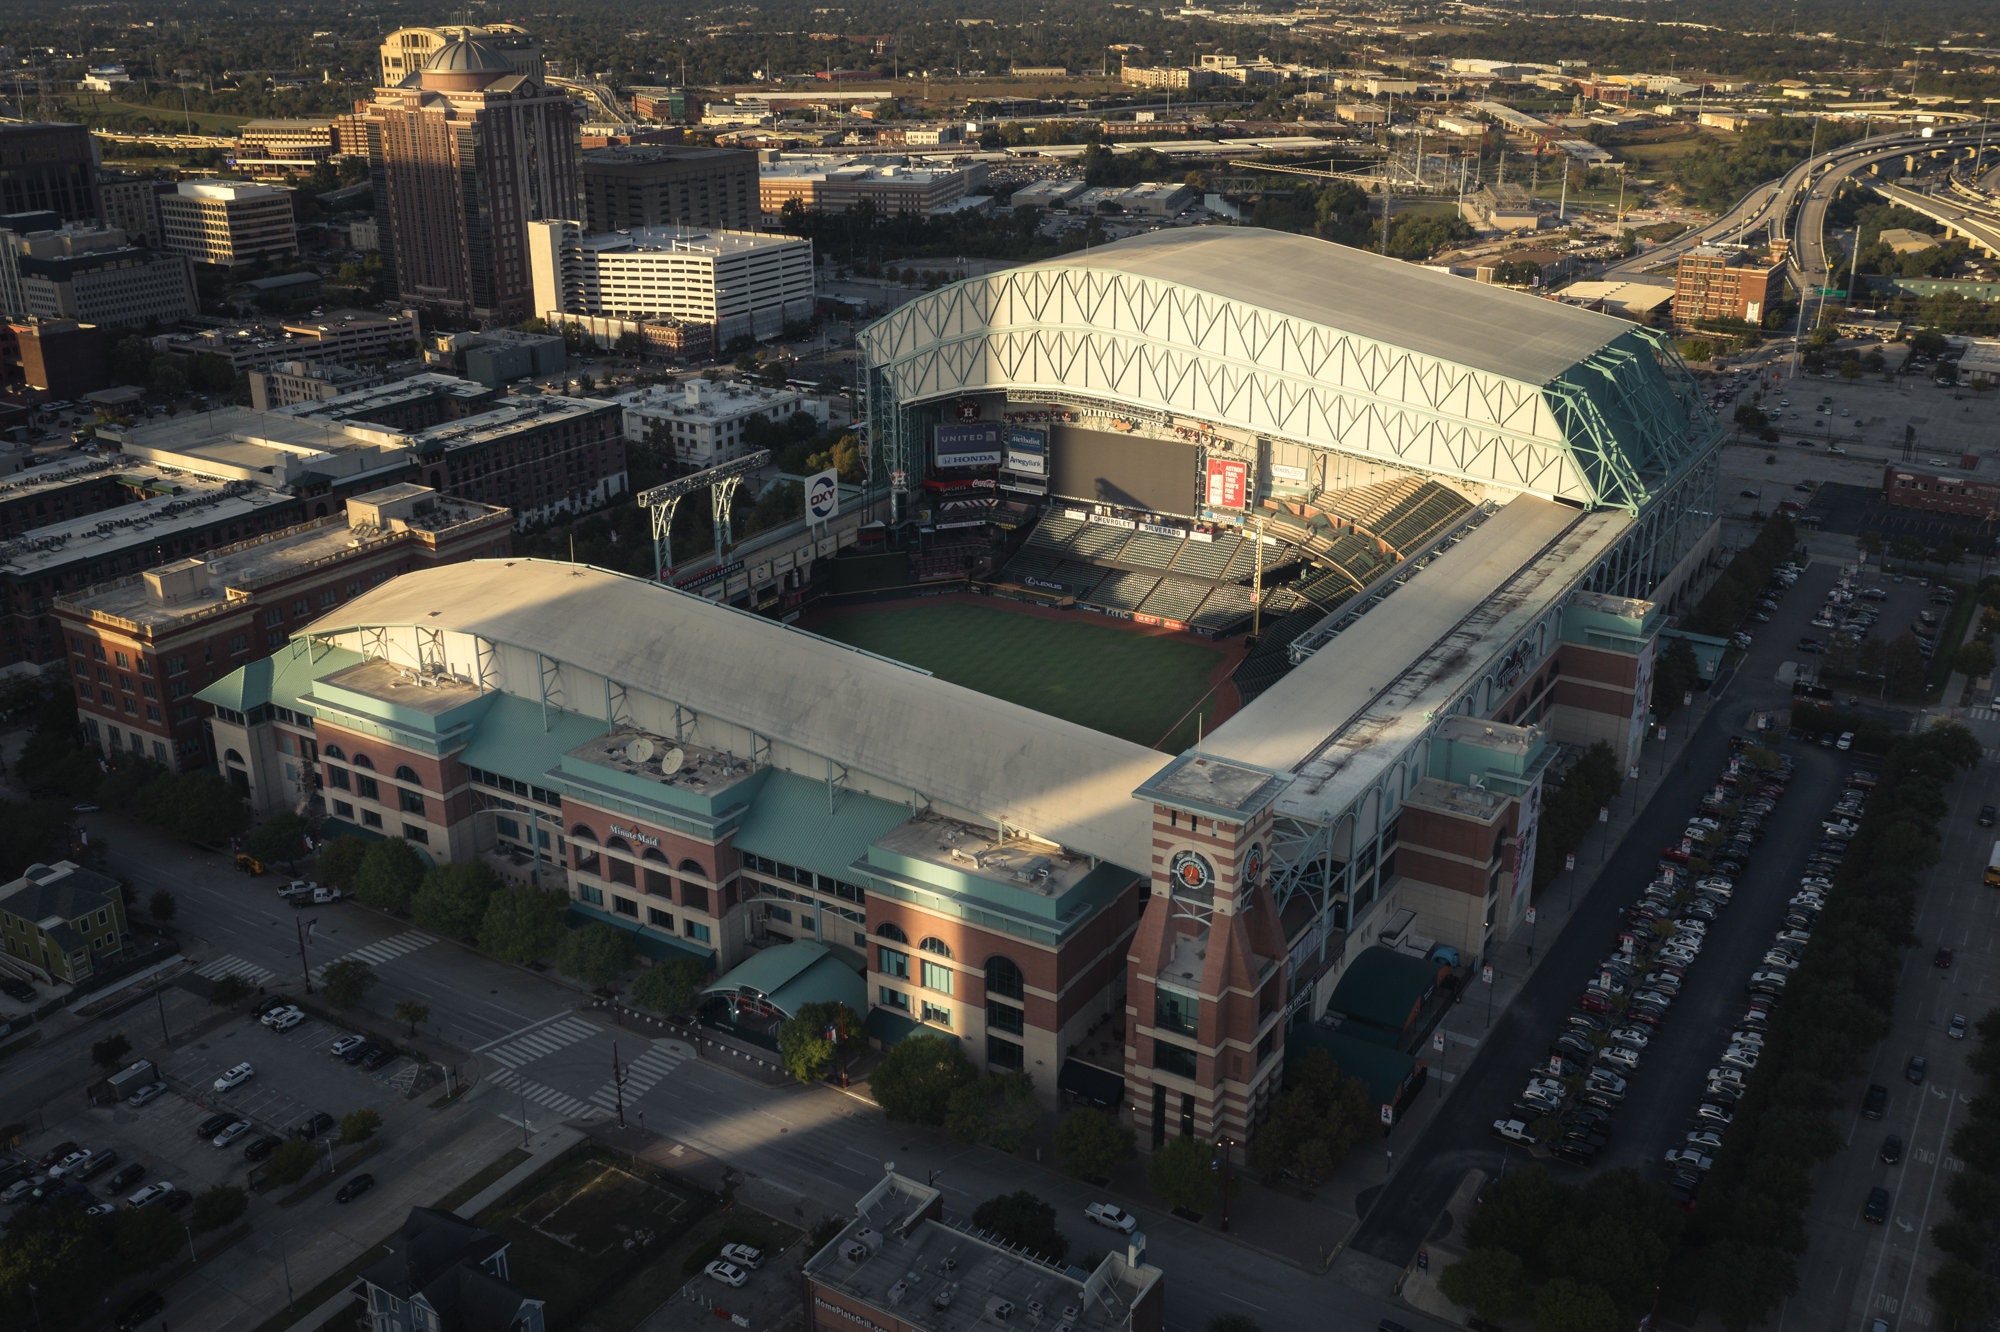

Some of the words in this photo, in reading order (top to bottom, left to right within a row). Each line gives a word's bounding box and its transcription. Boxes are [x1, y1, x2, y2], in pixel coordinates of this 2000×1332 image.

[941, 434, 984, 443] UNITED
[1012, 436, 1040, 446] Methodist
[953, 455, 996, 463] HONDA
[810, 488, 836, 506] OXY
[1093, 516, 1132, 528] CHEVROLET
[1144, 524, 1181, 537] SILVERADO
[680, 573, 715, 591] COMMUNITY
[1036, 580, 1062, 590] LEXUS
[610, 824, 637, 840] Minute
[637, 833, 658, 847] Maid
[1914, 1148, 1935, 1165] ONLY
[1942, 1156, 1966, 1173] ONLY
[1874, 1294, 1899, 1315] ONLY
[815, 1297, 889, 1332] HomePlateGrill.co
